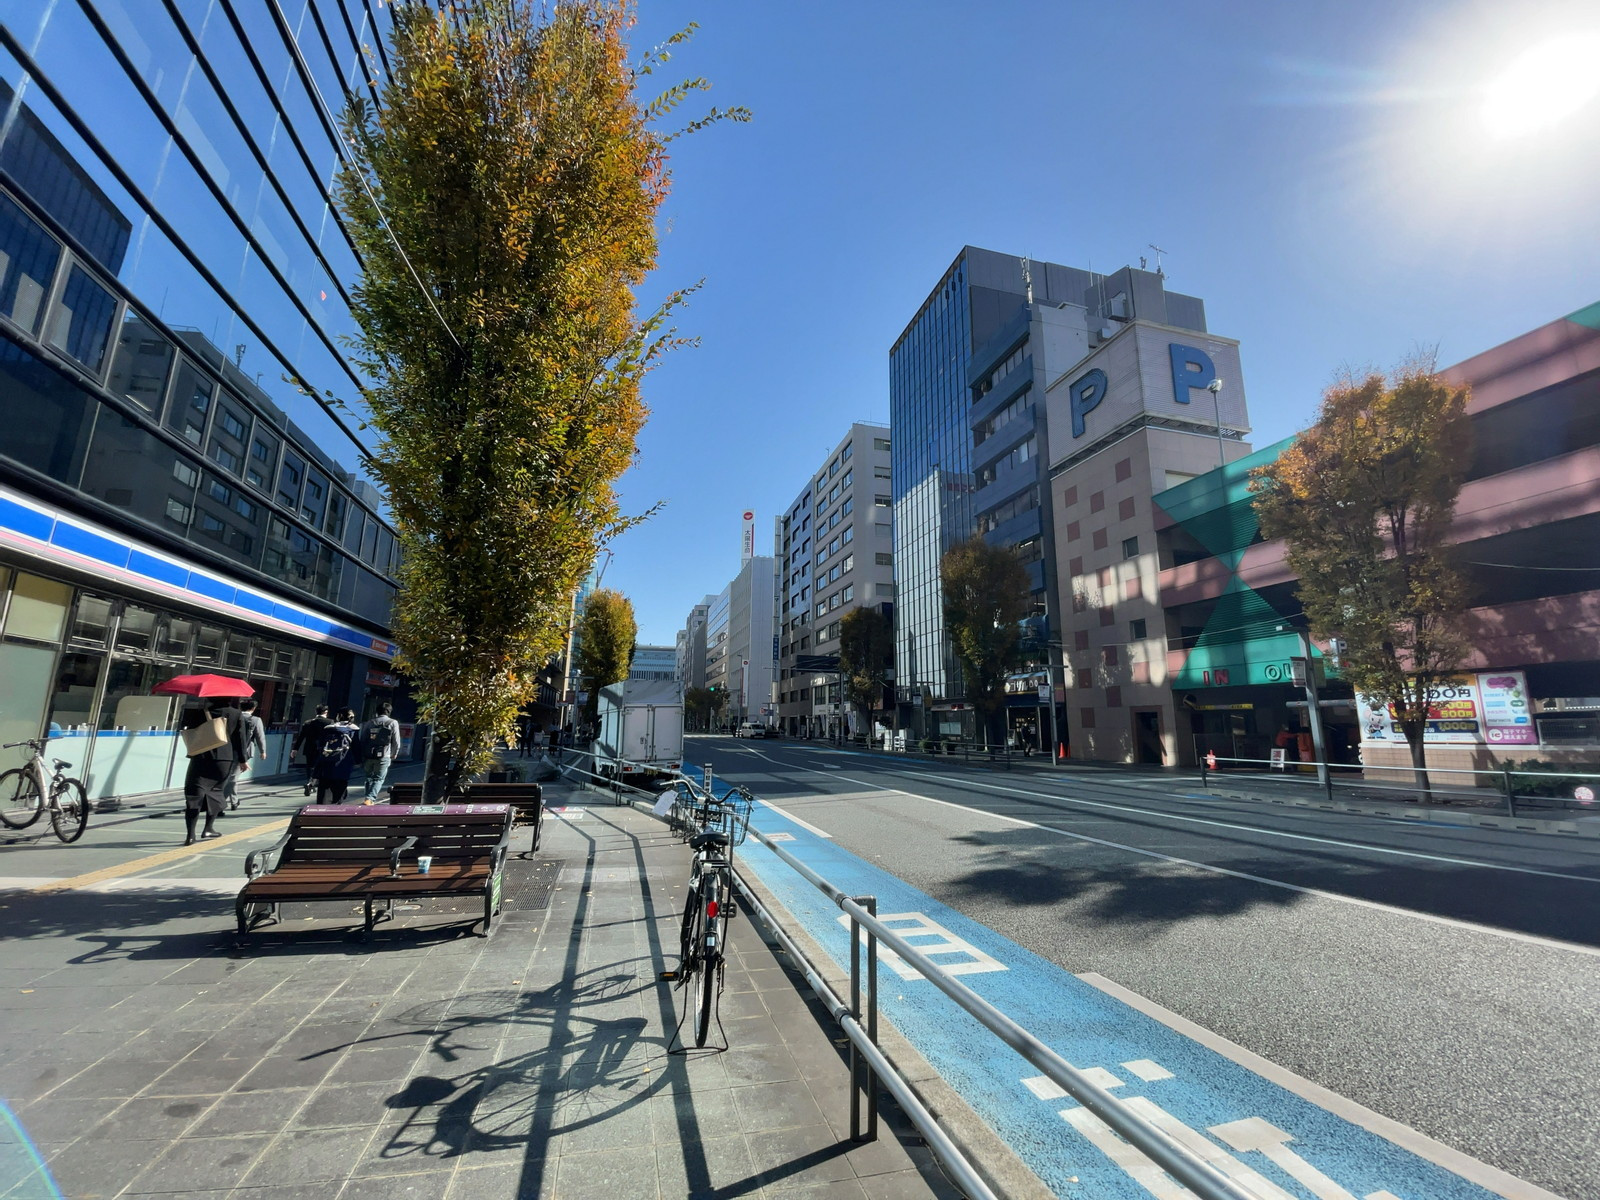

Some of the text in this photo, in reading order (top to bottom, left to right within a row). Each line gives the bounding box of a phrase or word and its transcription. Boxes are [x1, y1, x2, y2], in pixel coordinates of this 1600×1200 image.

[1069, 368, 1108, 439] P
[1169, 343, 1216, 404] P
[1203, 669, 1229, 686] IN
